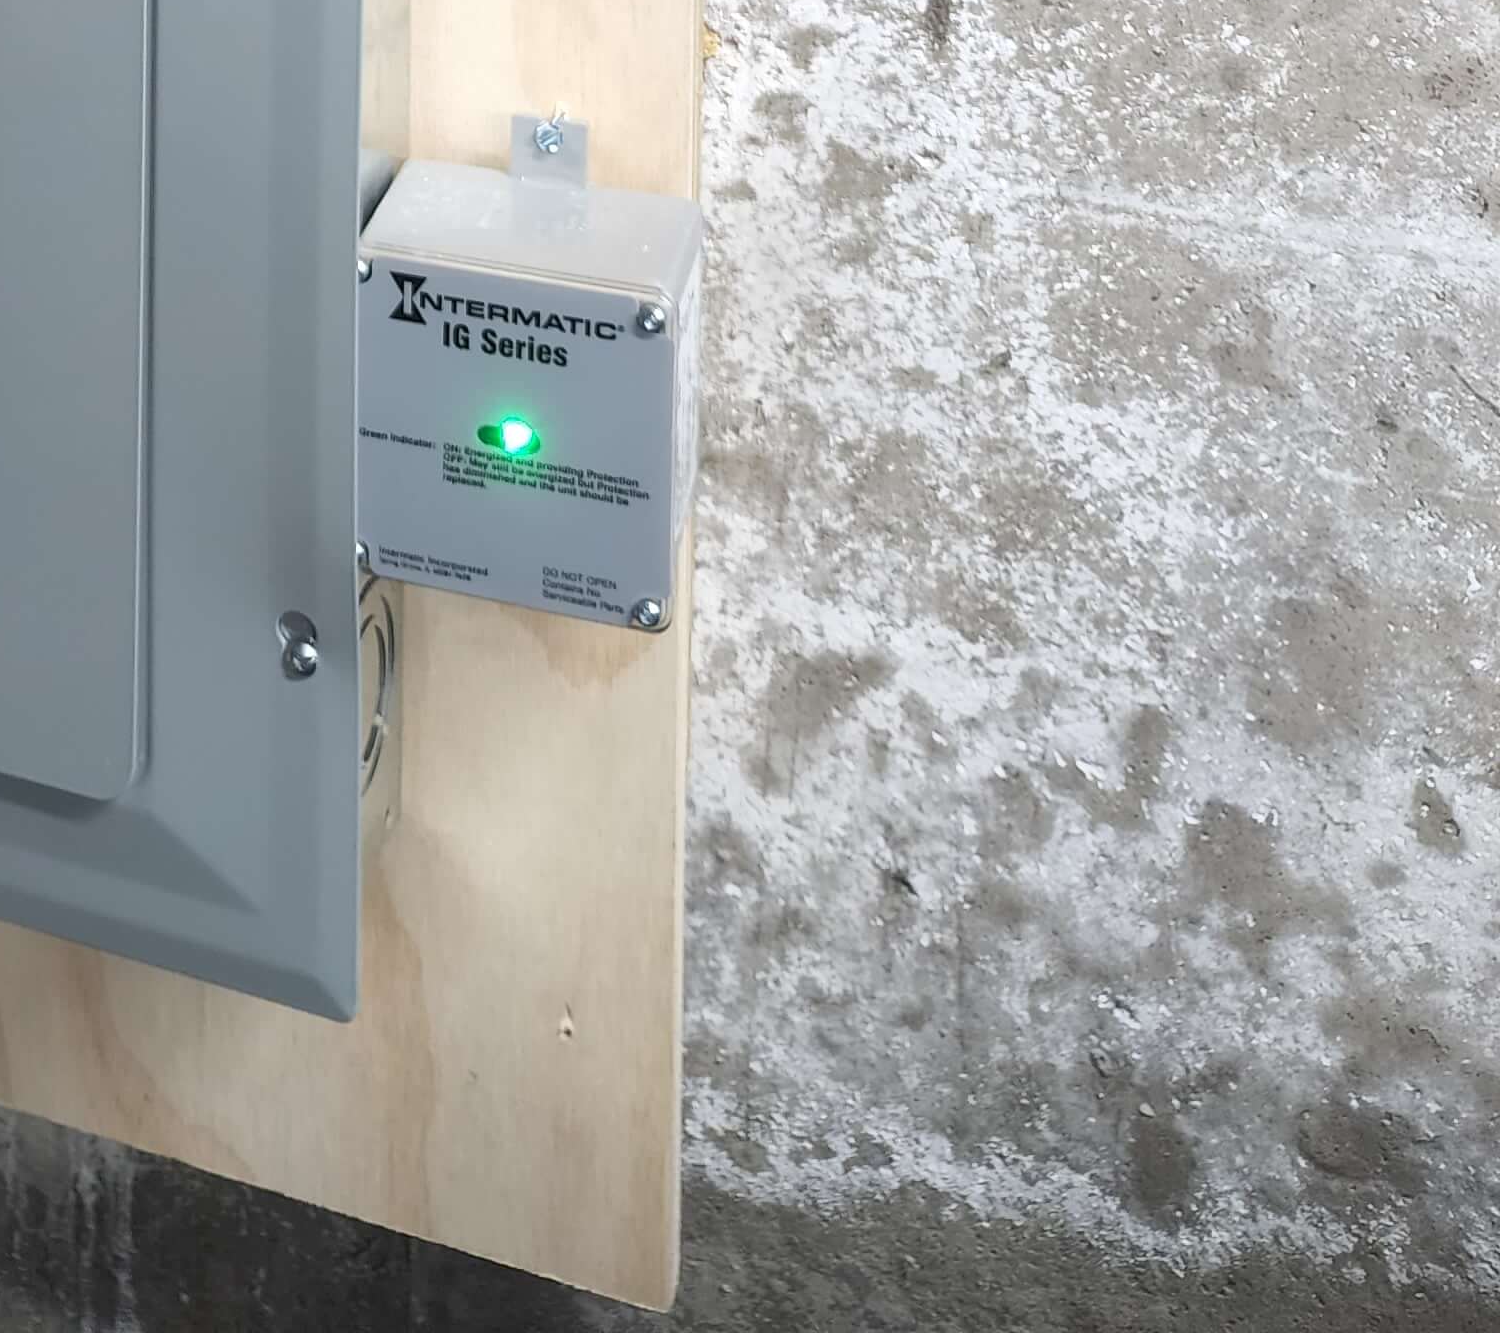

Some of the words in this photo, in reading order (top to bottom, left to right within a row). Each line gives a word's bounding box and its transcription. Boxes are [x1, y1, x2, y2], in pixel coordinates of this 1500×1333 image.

[389, 270, 619, 341] INTERMATIC
[442, 321, 470, 350] IG
[481, 328, 568, 367] Series
[360, 427, 388, 440] Green
[511, 464, 524, 475] be
[526, 469, 576, 486] energized
[578, 476, 594, 489] but
[597, 481, 650, 501] Protection
[516, 458, 534, 468] and
[536, 461, 584, 479] providing
[586, 468, 640, 488] Protection
[518, 478, 537, 488] and
[540, 481, 556, 492] the
[558, 485, 577, 496] unit
[580, 489, 614, 504] should
[616, 495, 629, 506] be
[542, 565, 559, 578] DO
[561, 570, 583, 582] NOT
